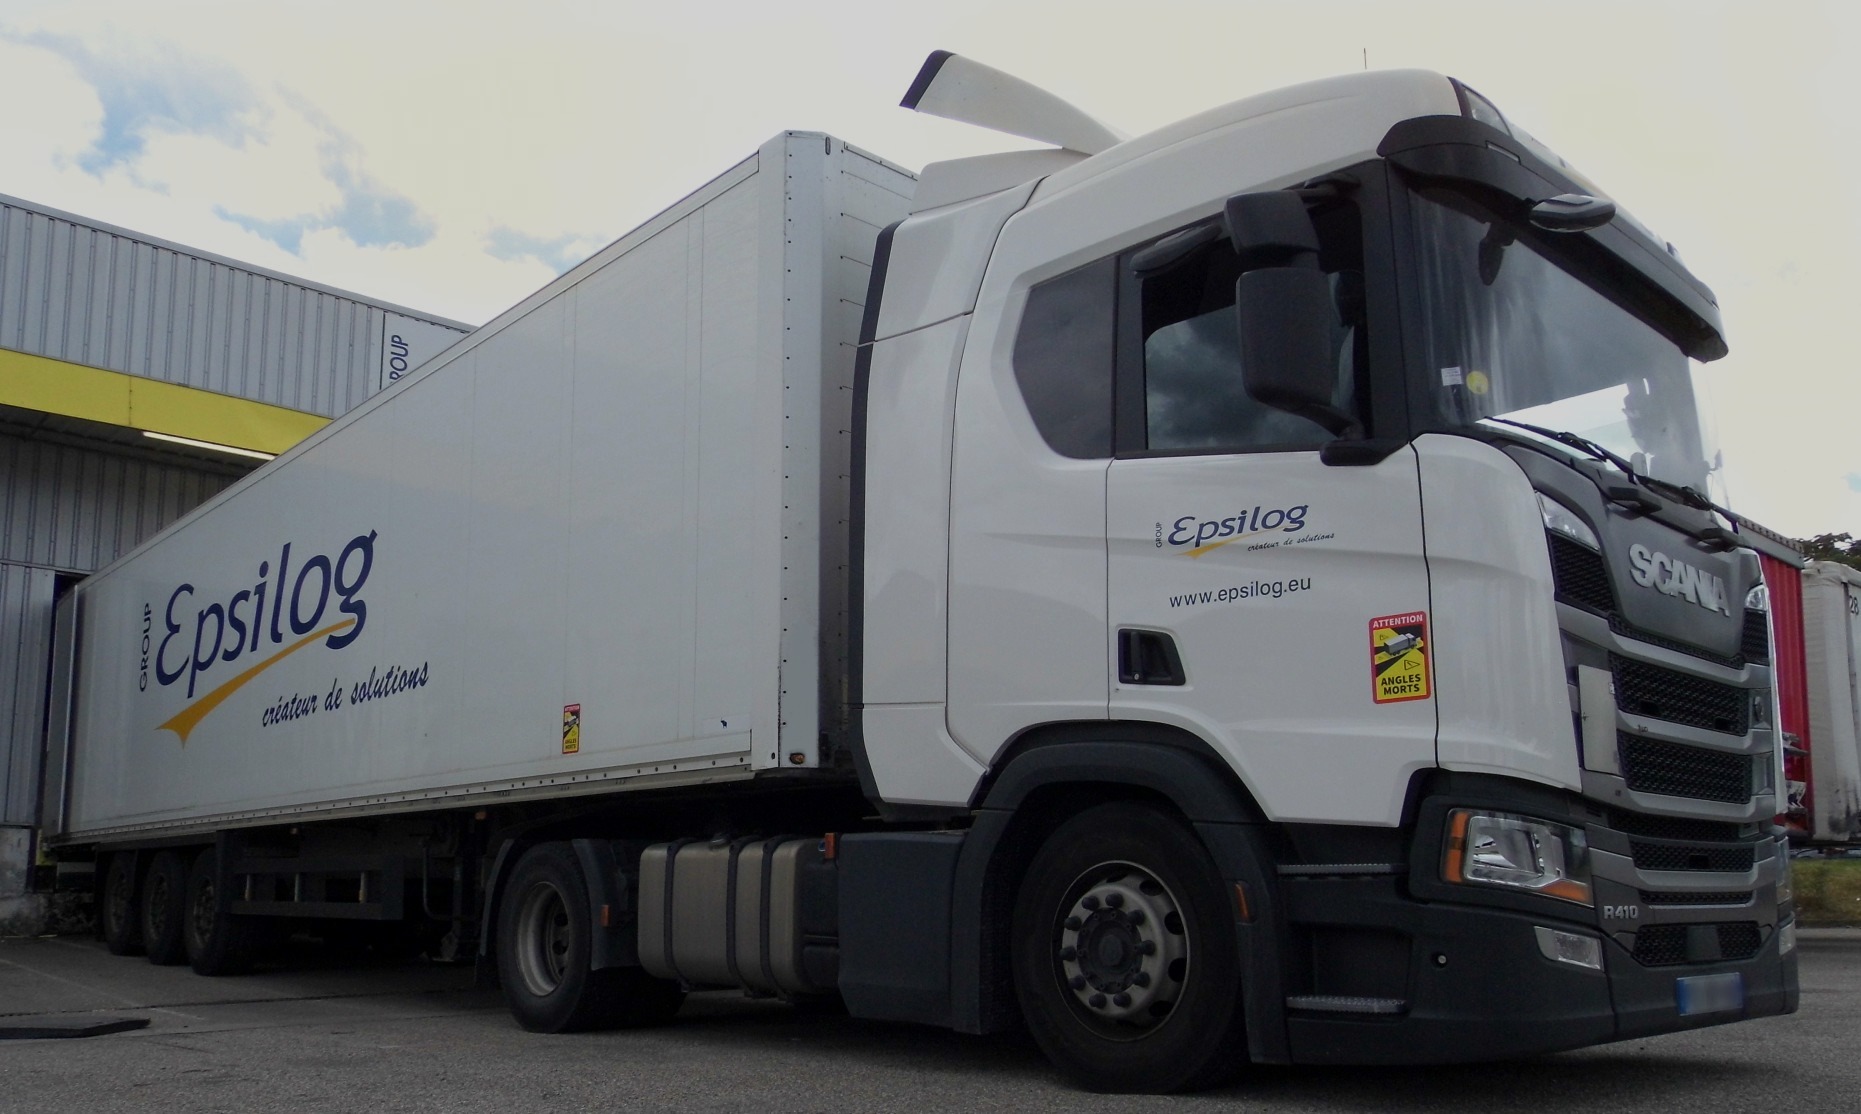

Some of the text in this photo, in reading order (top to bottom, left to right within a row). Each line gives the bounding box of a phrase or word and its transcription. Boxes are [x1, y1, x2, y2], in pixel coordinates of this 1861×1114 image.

[389, 334, 408, 384] ROUP
[1167, 504, 1309, 548] Epsilog
[1247, 532, 1335, 552] créateur de solutions
[1169, 577, 1311, 608] www.epsilog.eu
[1629, 543, 1730, 617] SCANIA
[155, 529, 378, 699] Epsilog
[1373, 614, 1423, 628] ATTENTION
[139, 602, 152, 692] GROUP
[262, 661, 430, 728] créateur de solutions
[1381, 674, 1421, 686] ANGLES
[1383, 683, 1420, 696] MORTS
[1603, 905, 1639, 920] R410
